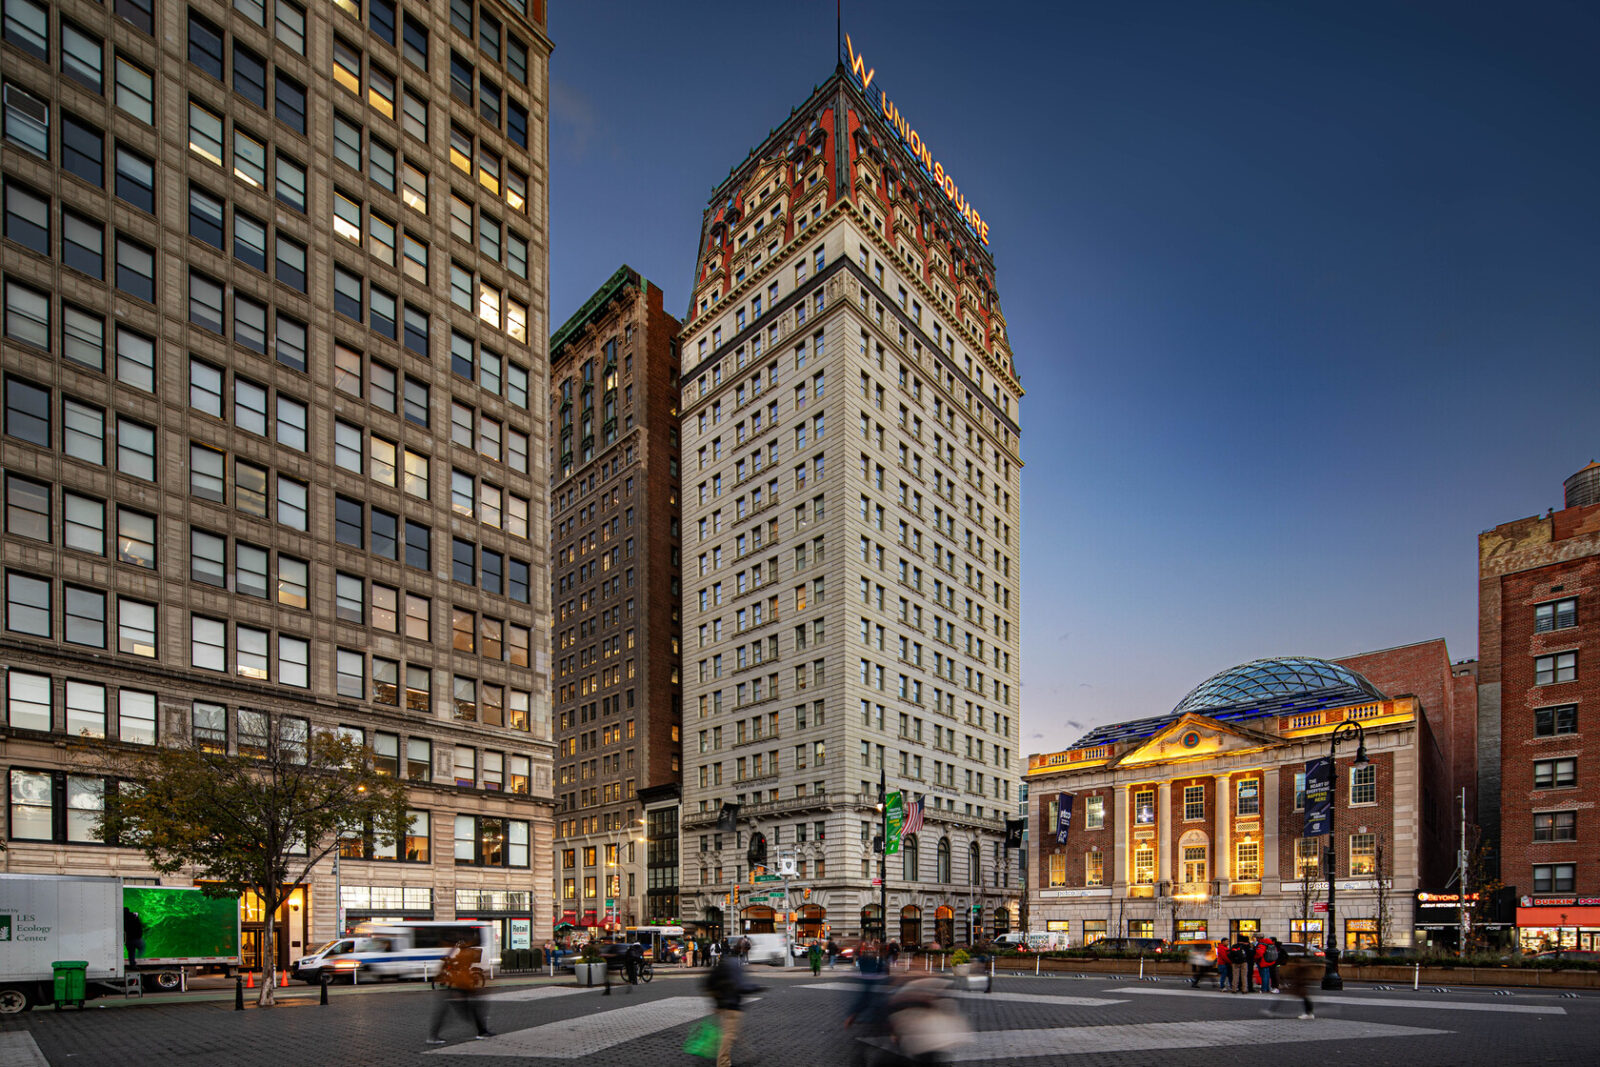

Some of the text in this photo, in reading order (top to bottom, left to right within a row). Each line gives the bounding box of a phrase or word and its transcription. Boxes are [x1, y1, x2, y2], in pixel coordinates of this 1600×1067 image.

[846, 32, 990, 246] W UNION SQUARE
[17, 925, 52, 934] Ecology
[512, 924, 529, 932] Retail
